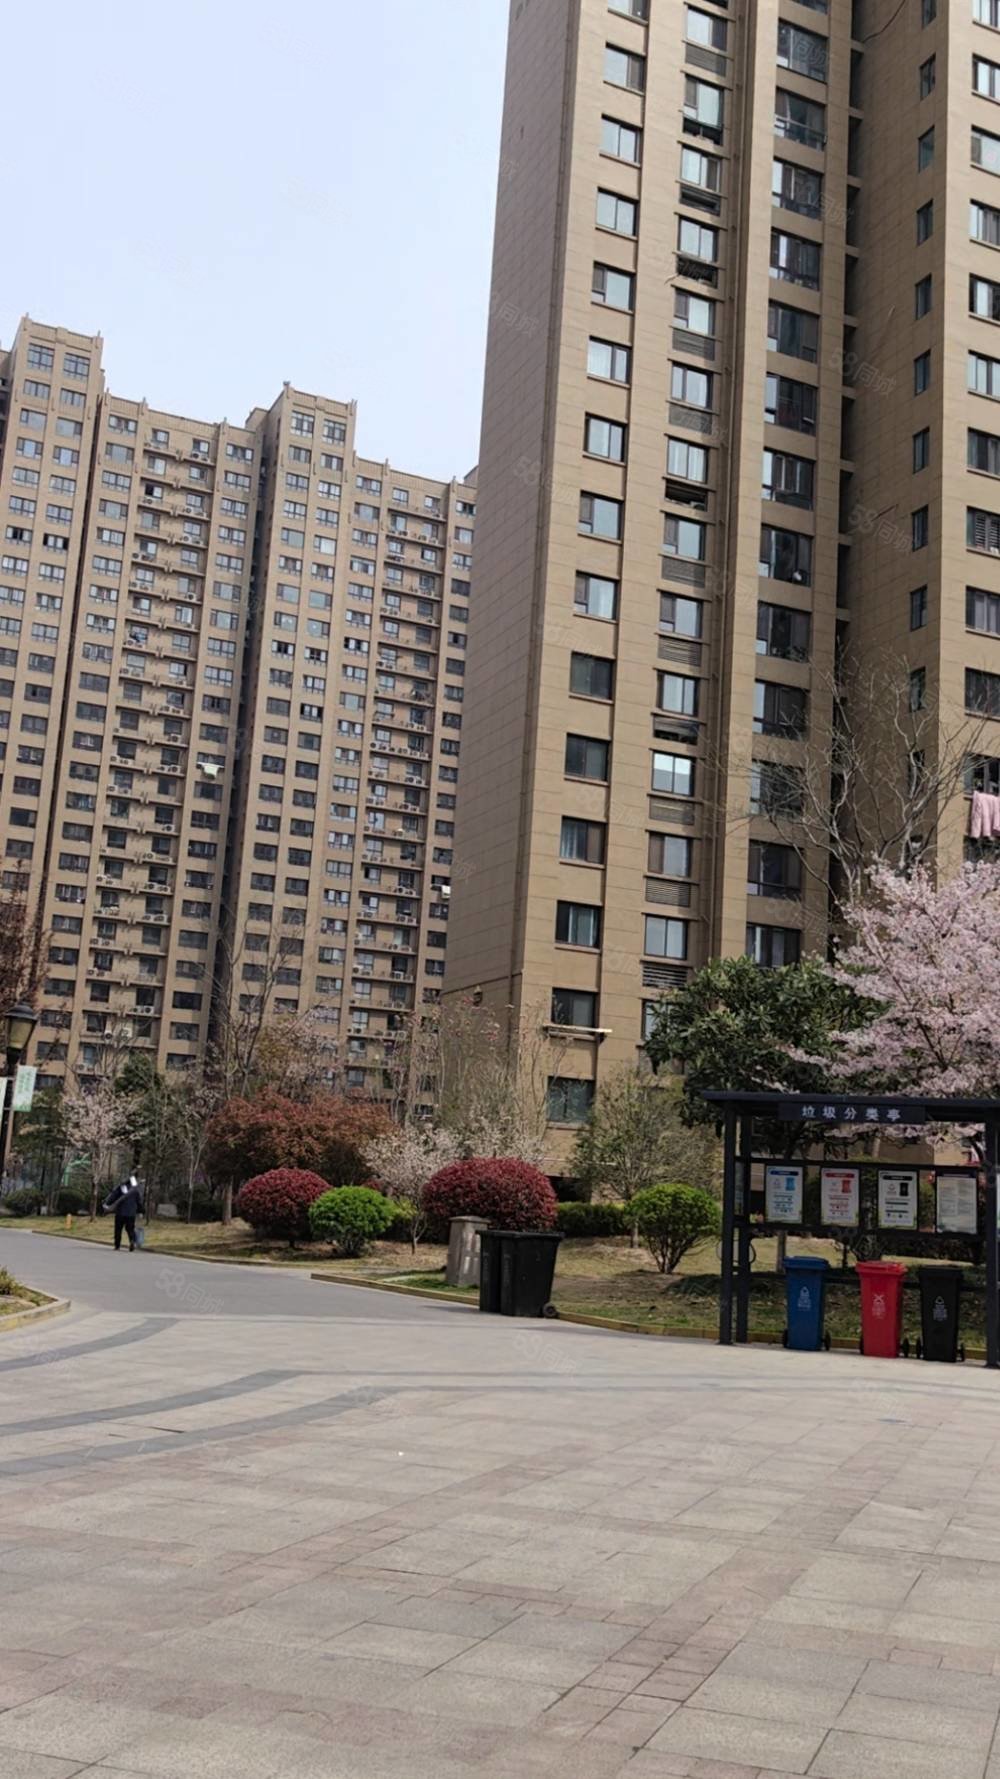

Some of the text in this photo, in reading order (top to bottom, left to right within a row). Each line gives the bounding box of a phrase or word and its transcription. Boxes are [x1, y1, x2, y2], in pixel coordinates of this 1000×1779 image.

[801, 1105, 901, 1121] 垃圾分类亭
